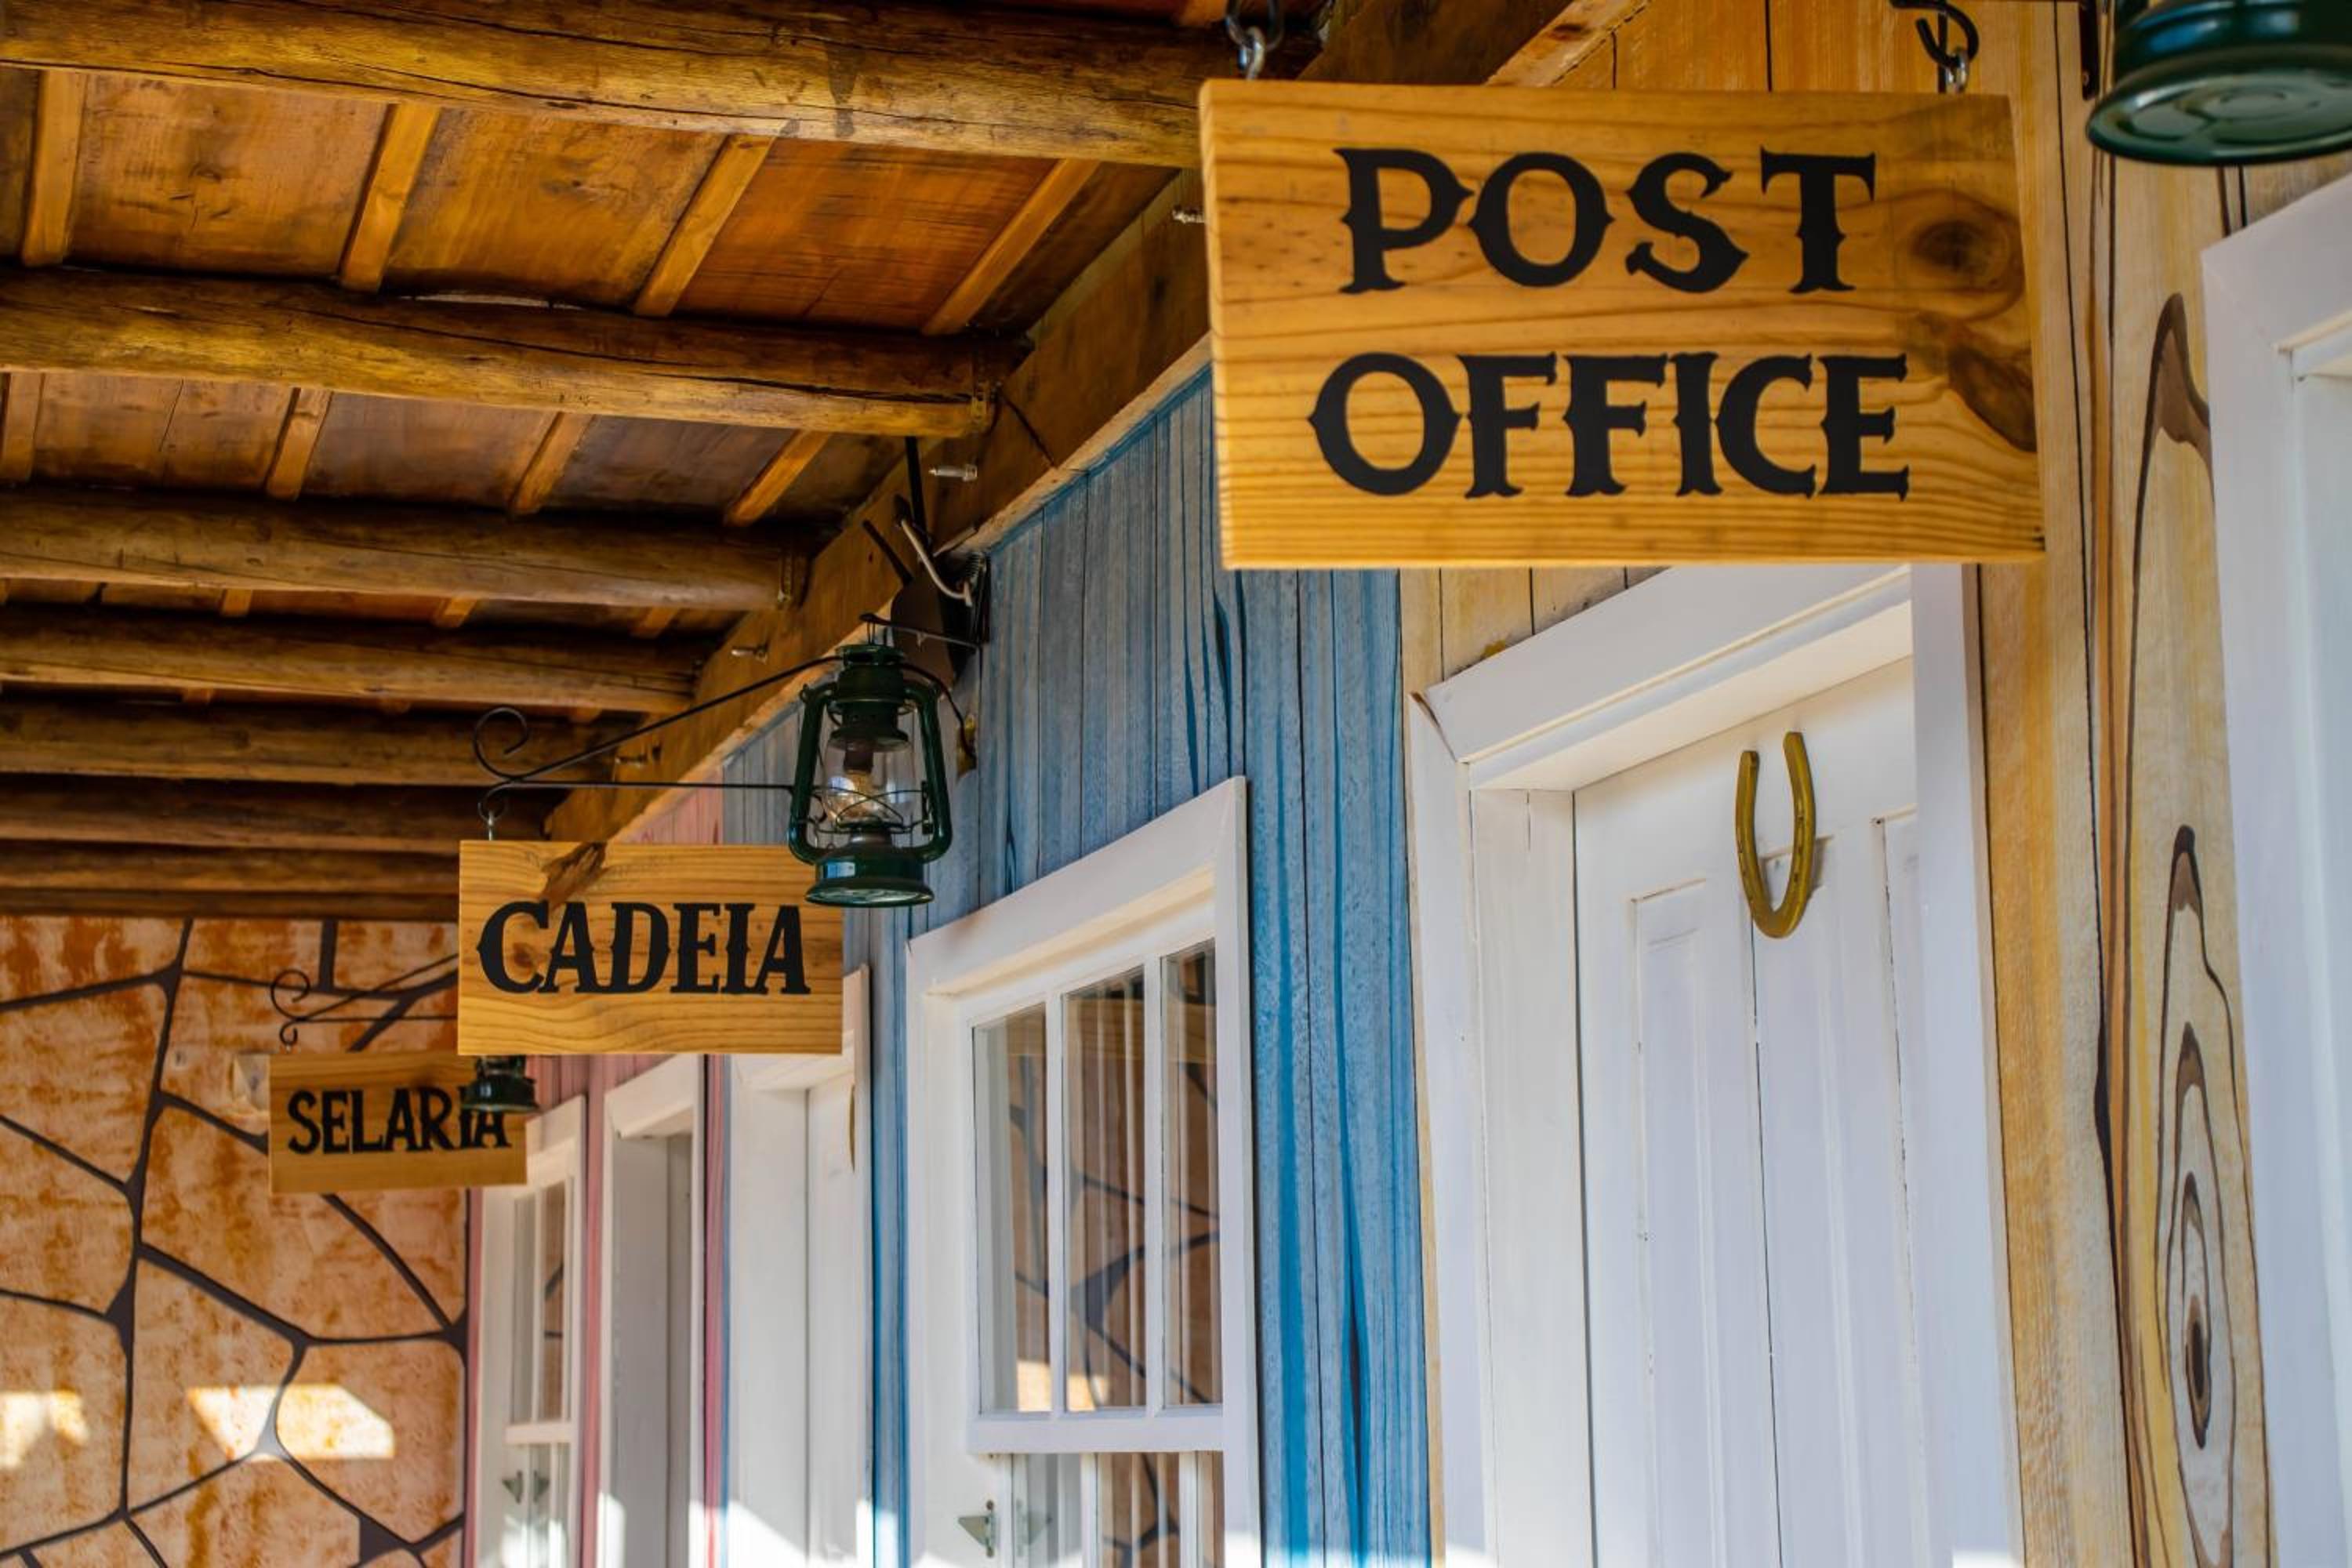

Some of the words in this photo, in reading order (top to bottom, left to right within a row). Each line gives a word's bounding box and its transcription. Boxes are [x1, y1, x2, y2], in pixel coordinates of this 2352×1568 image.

[1332, 147, 1875, 293] POST
[1308, 351, 1910, 500] OFFICE
[477, 900, 811, 995] CADEIA
[288, 1086, 512, 1154] SELARIA
